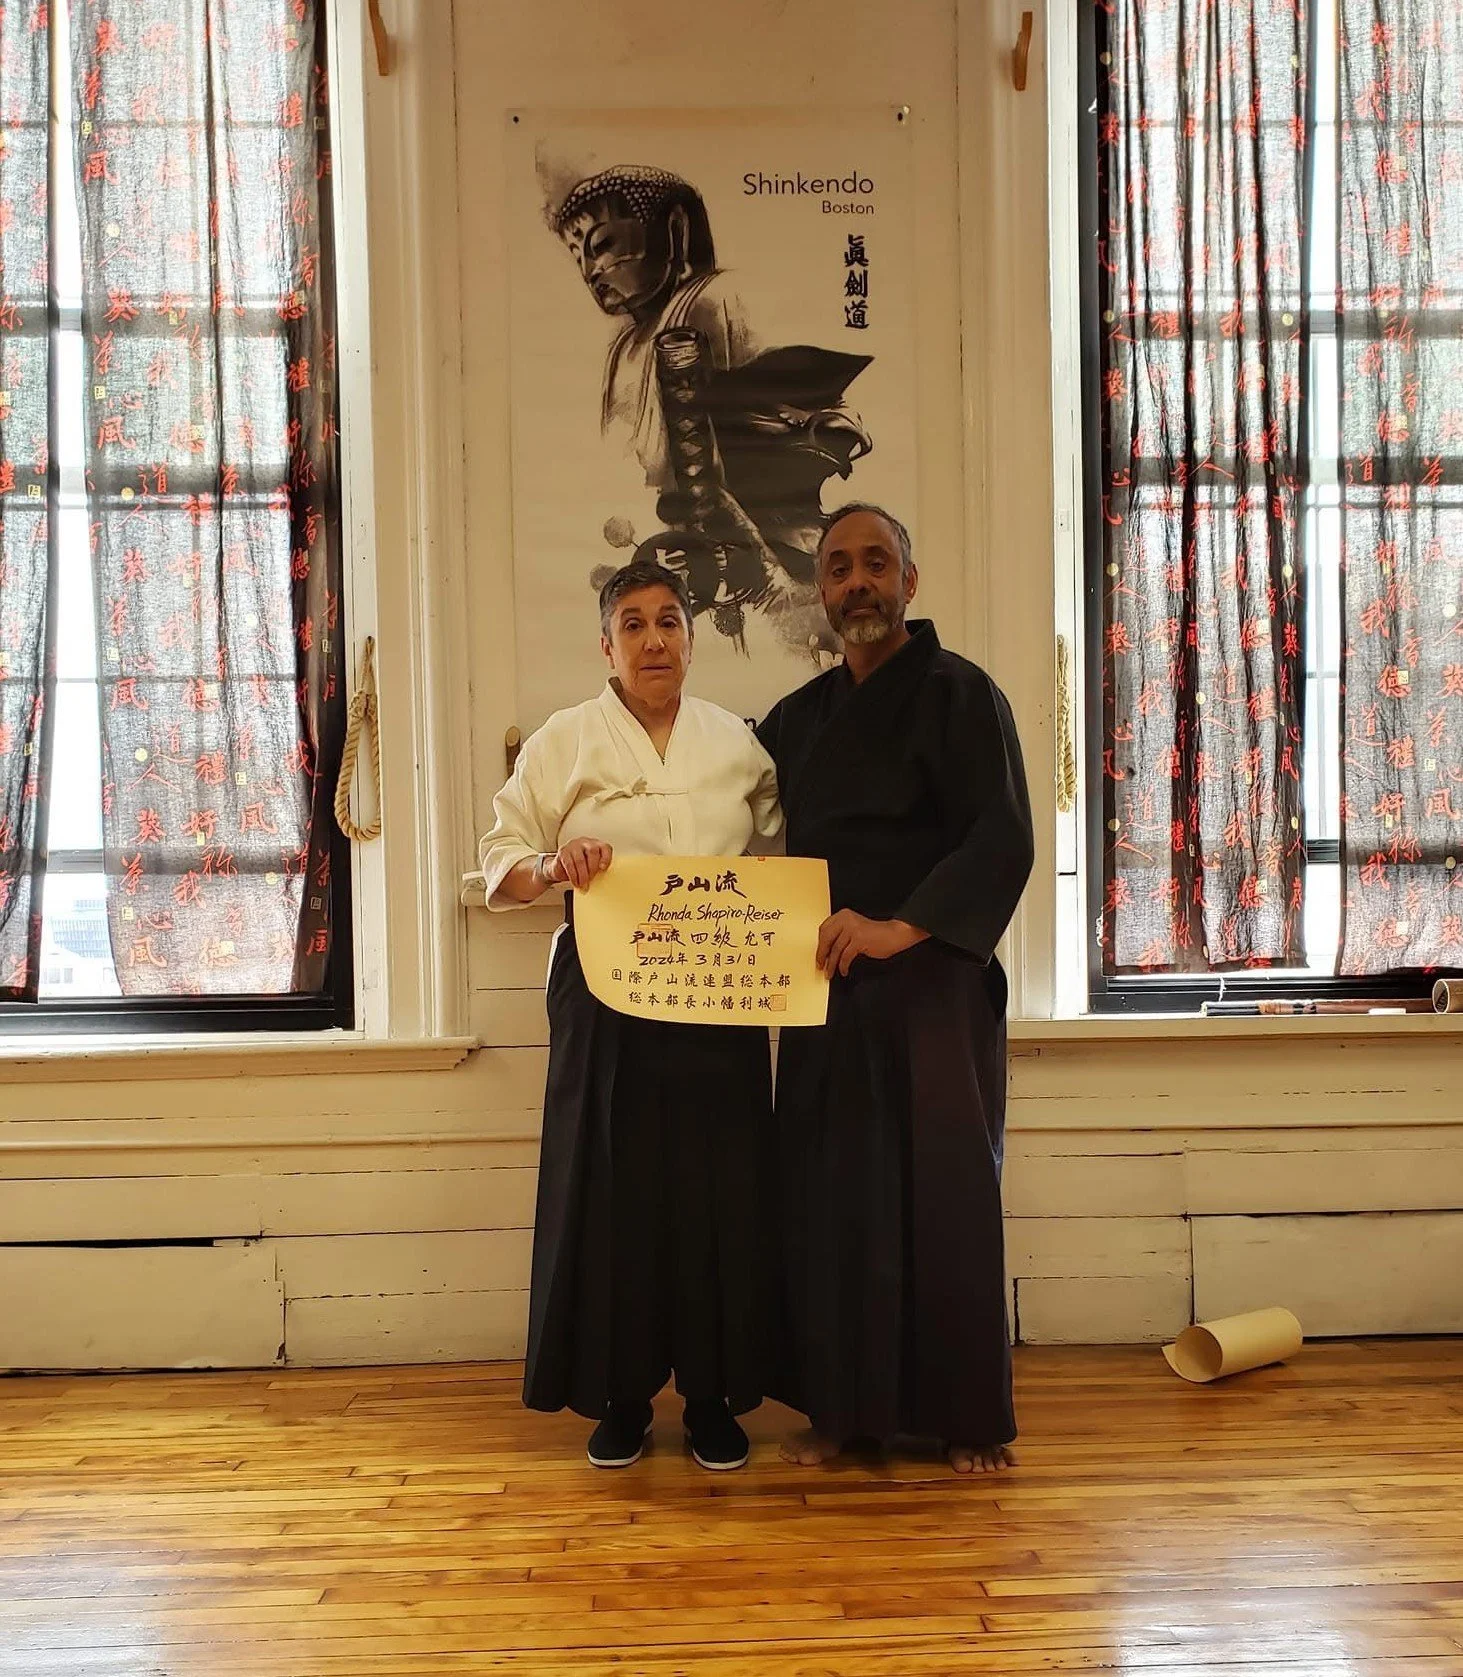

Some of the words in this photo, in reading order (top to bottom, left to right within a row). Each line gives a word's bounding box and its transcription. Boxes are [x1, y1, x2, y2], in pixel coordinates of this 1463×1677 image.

[743, 170, 874, 196] Shinkendo
[822, 200, 875, 215] Boston
[648, 903, 693, 922] Rhonda
[696, 902, 785, 927] Shapiro-Reiser
